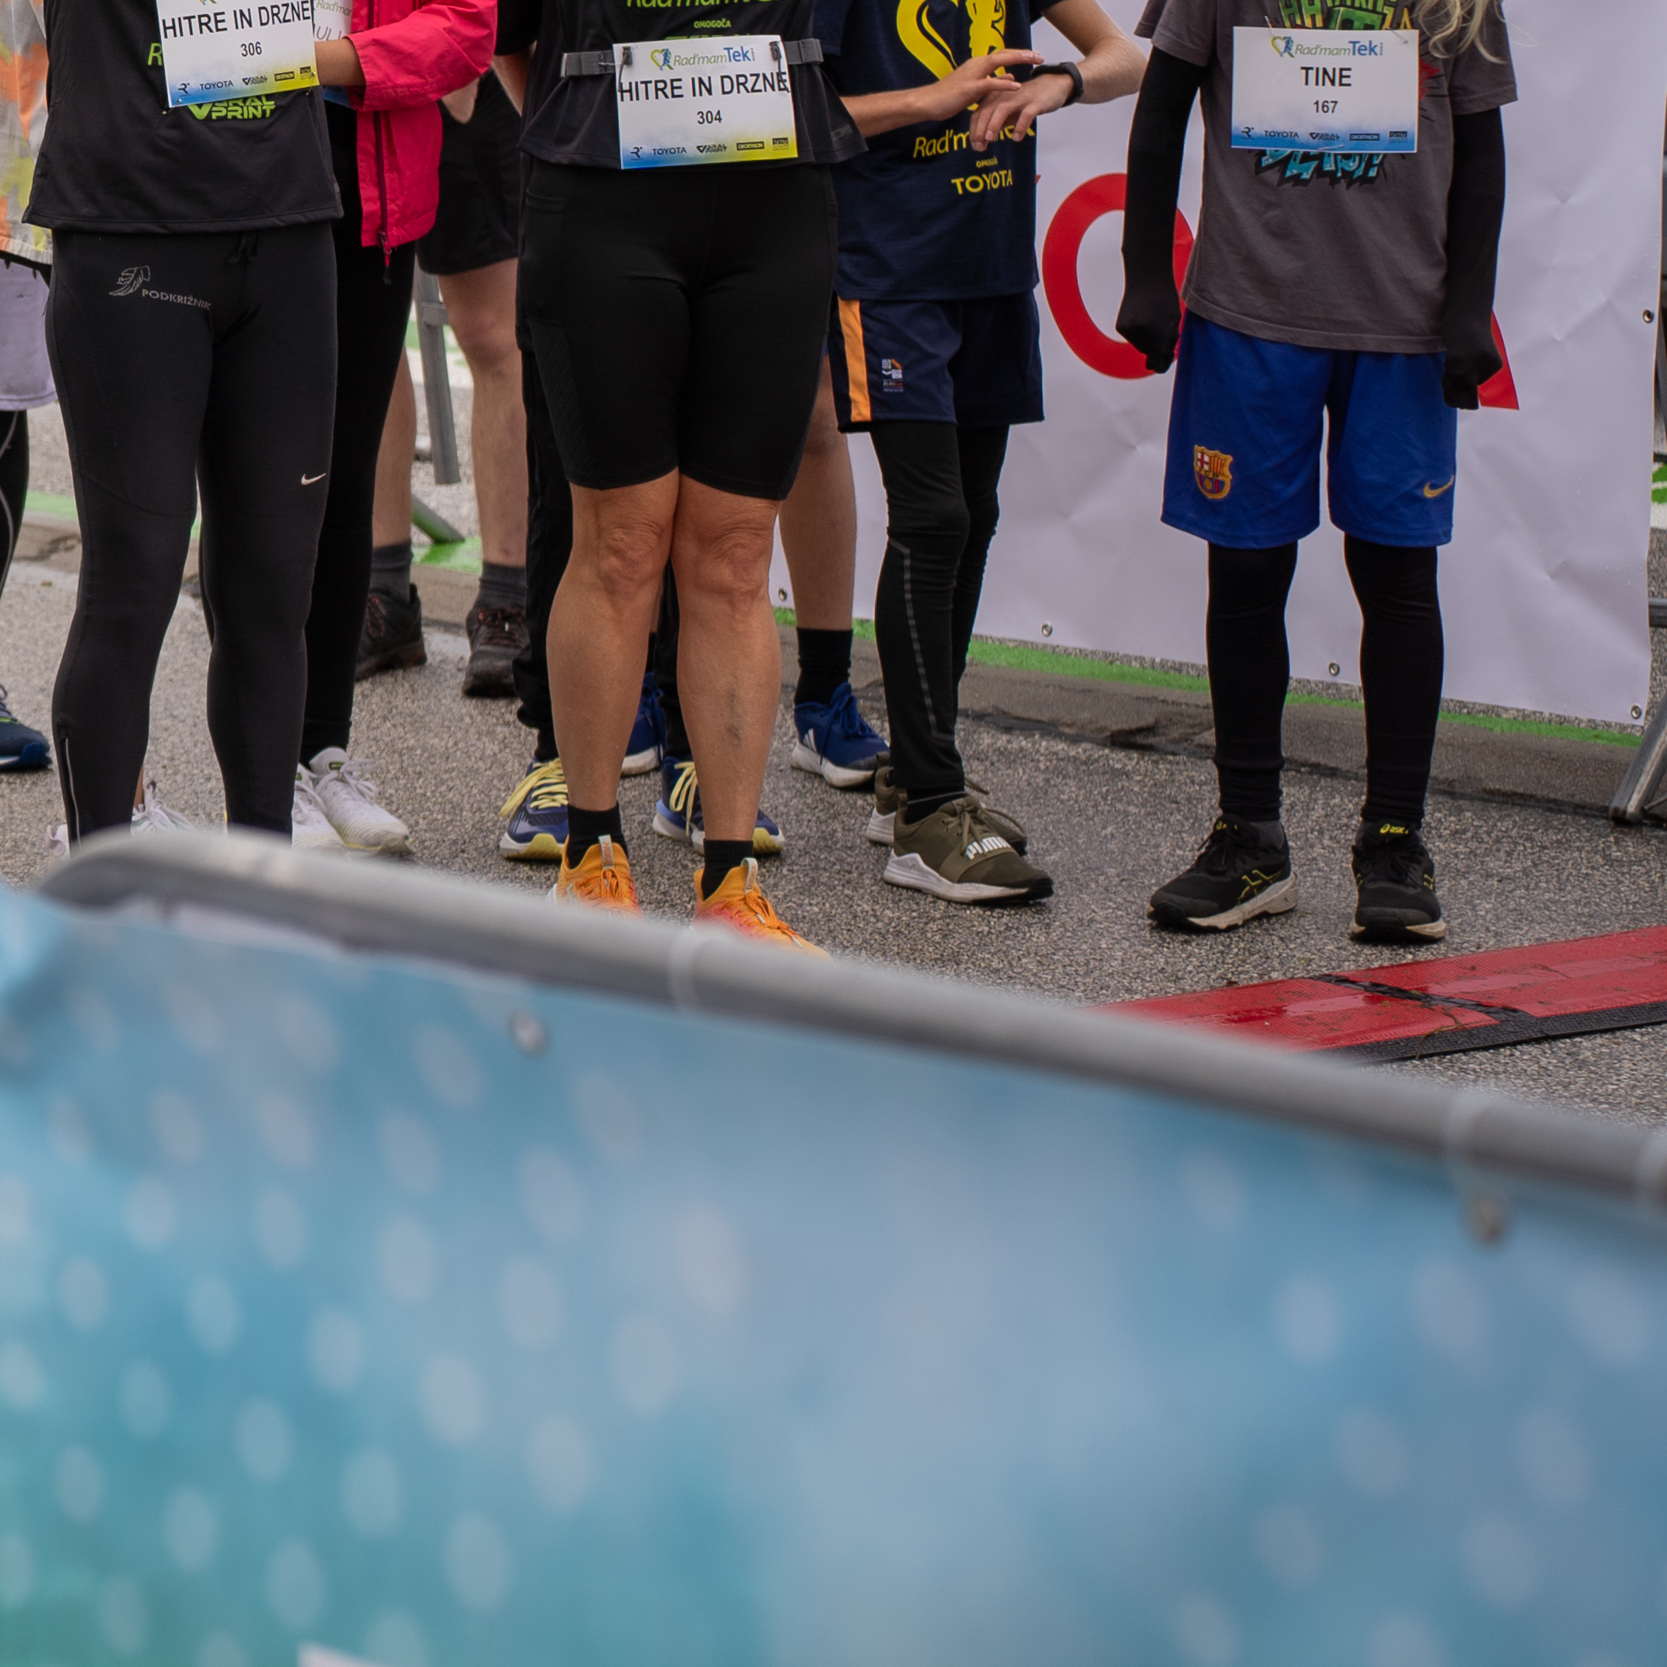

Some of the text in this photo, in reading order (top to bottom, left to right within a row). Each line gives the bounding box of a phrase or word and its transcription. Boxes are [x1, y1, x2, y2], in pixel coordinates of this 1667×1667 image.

[162, 0, 311, 39] HITRE IN DRZNE
[693, 18, 732, 28] OMOGOČA
[240, 41, 263, 57] 306
[1300, 66, 1352, 87] TINE
[199, 80, 234, 91] TOYOTA
[619, 71, 788, 103] HITRE IN DRZNE
[1313, 100, 1338, 114] 167
[697, 110, 723, 125] 304
[1264, 130, 1299, 139] TOYOTA
[652, 146, 687, 156] TOYOTA
[951, 169, 1014, 195] TOYOTA
[141, 289, 212, 311] PODKRIŽNIK
